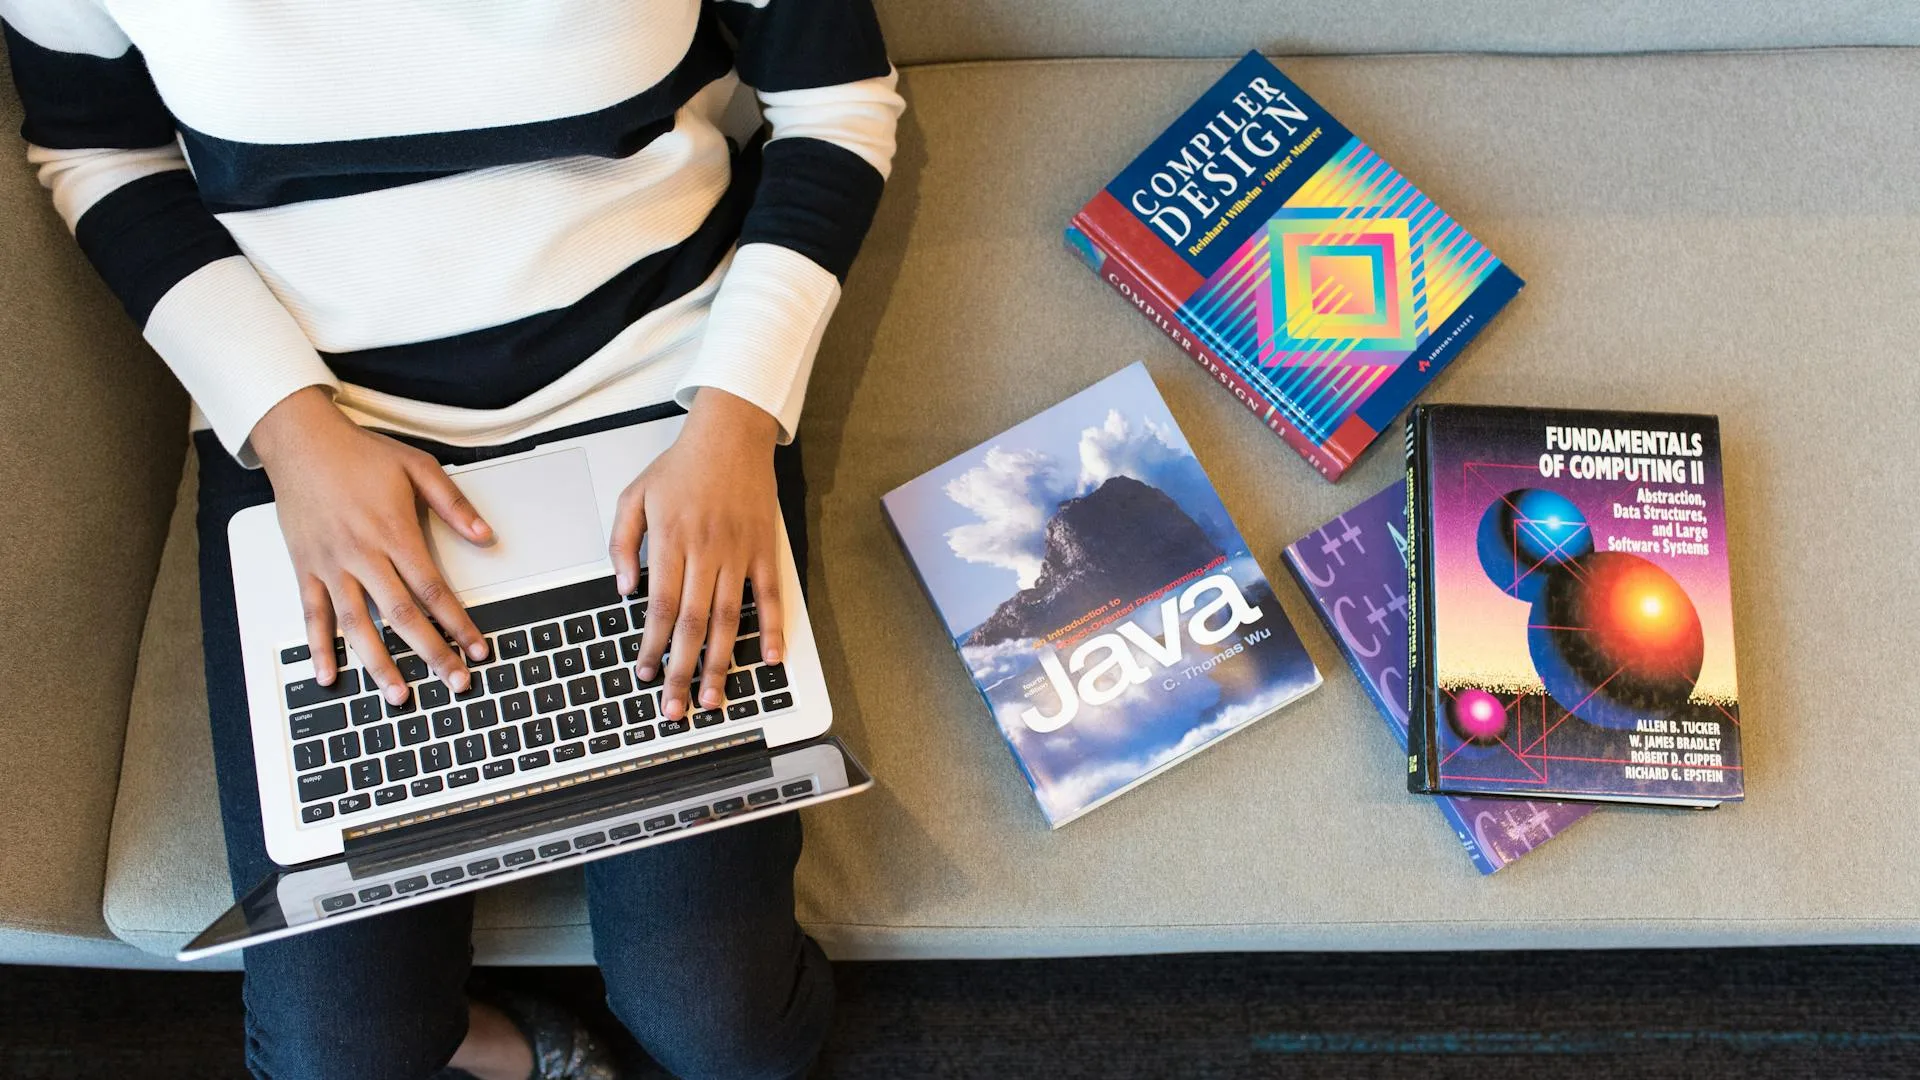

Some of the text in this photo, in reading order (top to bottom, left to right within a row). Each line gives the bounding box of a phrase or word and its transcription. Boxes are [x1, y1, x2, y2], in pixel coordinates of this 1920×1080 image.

[1132, 77, 1281, 215] COMPILER
[1150, 92, 1309, 246] DESIGN
[1188, 126, 1323, 256] Reinhard Wilhelm Dieter Maurer
[1108, 272, 1260, 412] COMPILER DESIGN
[1546, 426, 1703, 457] FUNDAMENTALS
[1539, 453, 1705, 485] OF COMPUTING II
[1636, 487, 1707, 508] Abstraction,
[1613, 503, 1707, 525] Data Structures,
[1652, 523, 1709, 542] and Large
[1607, 535, 1710, 558] Software Systems
[1055, 555, 1228, 650] Object-Oriented Programming with
[1048, 605, 1109, 642] Introduction
[1110, 597, 1121, 609] to
[1334, 583, 1408, 658] C++
[509, 640, 517, 648] N
[632, 643, 640, 651] D
[565, 658, 572, 666] G
[600, 651, 605, 659] F
[1021, 574, 1263, 733] Java
[1163, 628, 1272, 691] C. Thomas Wu
[500, 674, 505, 682] J
[532, 666, 539, 674] H
[613, 678, 619, 686] R
[1022, 675, 1045, 690] fourth
[1024, 682, 1049, 698] edition
[512, 702, 519, 710] U
[547, 694, 552, 702] Y
[295, 713, 313, 721] return
[444, 718, 451, 726] O
[480, 710, 483, 718] I
[410, 726, 416, 734] P
[1636, 719, 1721, 736] ALLEN B. TUCKER
[1629, 734, 1721, 751] W. JAMES BRADLEY
[432, 748, 437, 756] 0
[1631, 750, 1723, 767] ROBERT D. CUPPER
[303, 774, 322, 783] delete
[1625, 766, 1724, 783] RICHARD G. EPSTEIN
